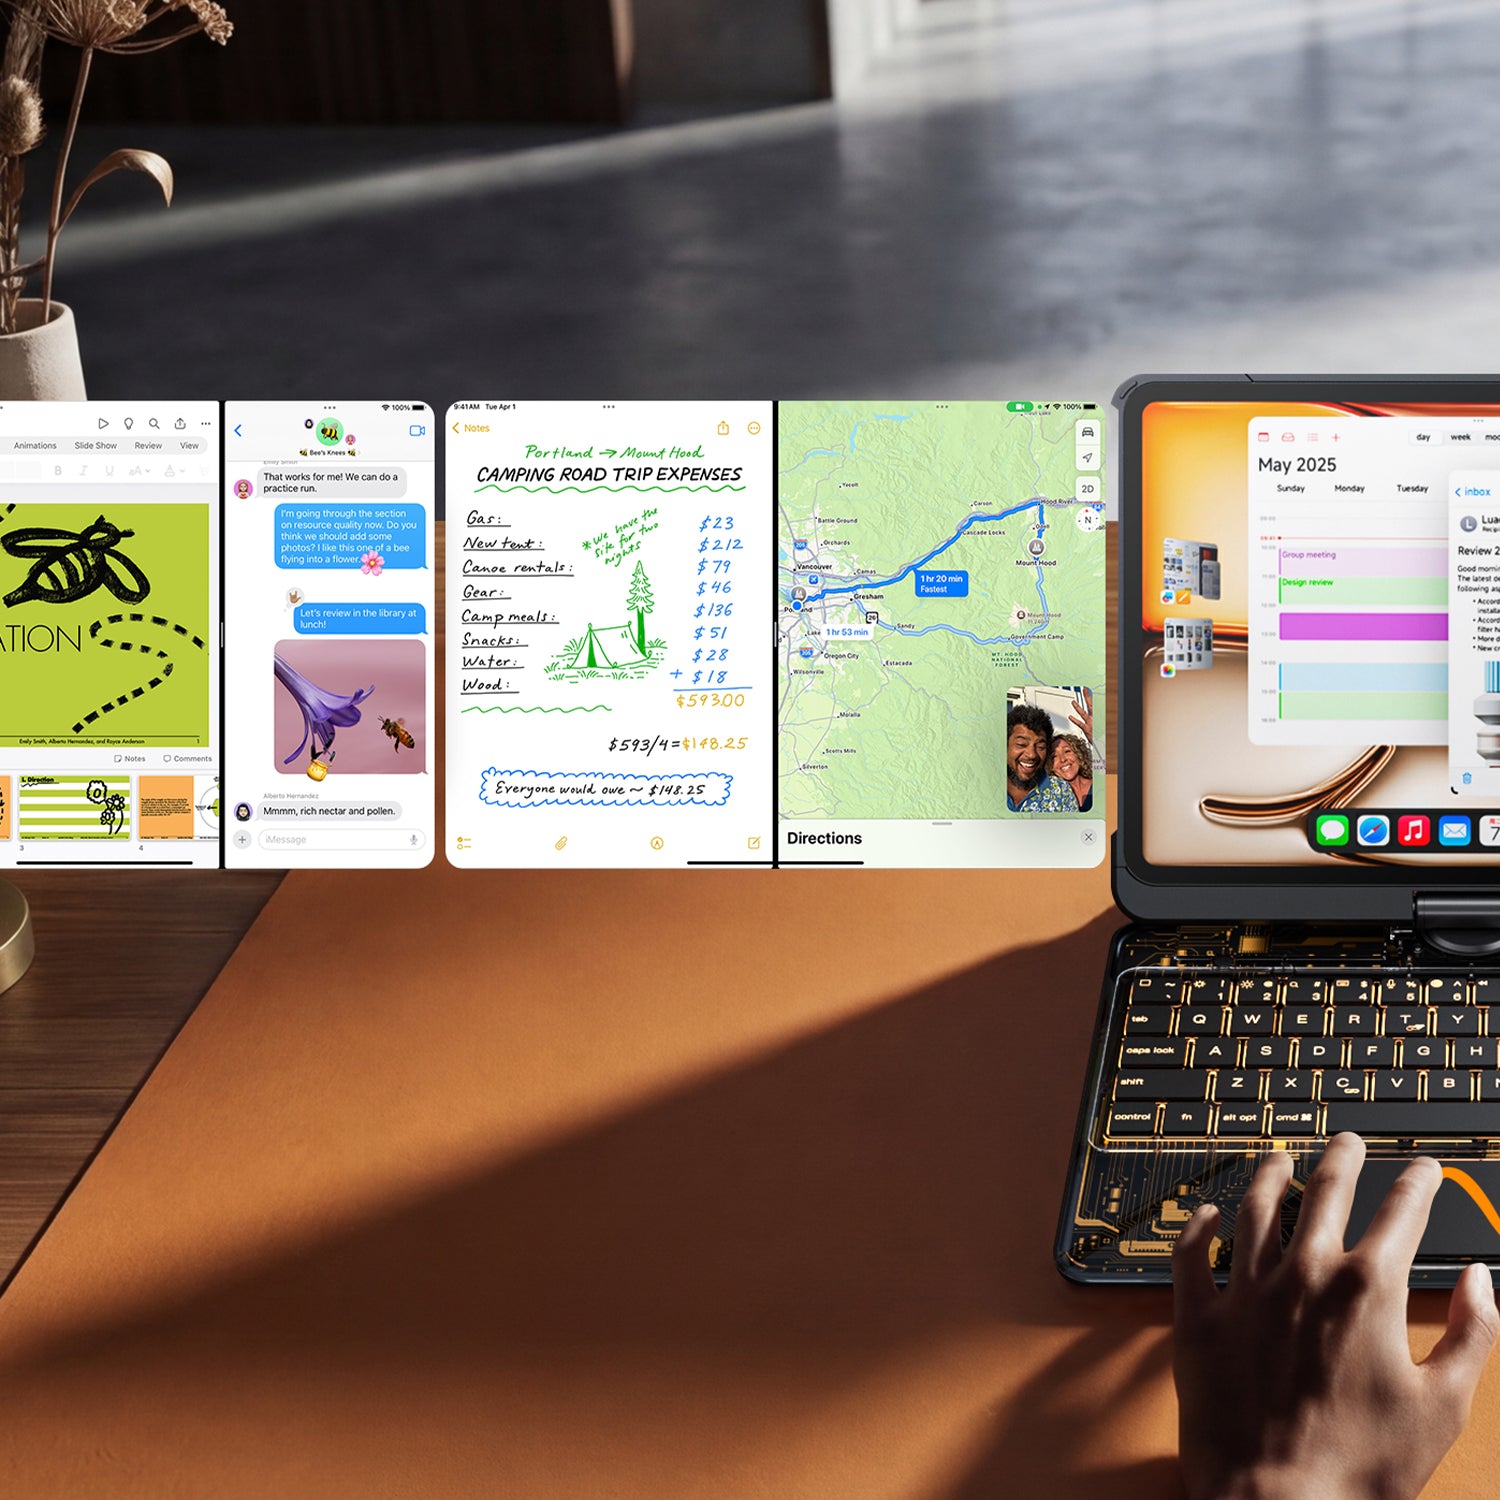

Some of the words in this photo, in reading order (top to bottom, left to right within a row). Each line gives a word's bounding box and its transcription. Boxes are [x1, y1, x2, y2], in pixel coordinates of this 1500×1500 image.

[391, 404, 411, 412] 100%
[485, 403, 498, 411] Tue
[498, 403, 511, 411] Apr
[463, 423, 491, 433] Notes
[1416, 433, 1431, 443] day
[1450, 433, 1471, 441] week
[13, 441, 58, 450] Animations
[74, 441, 94, 450] Slide
[95, 441, 118, 450] Show
[134, 441, 163, 450] Review
[179, 441, 200, 450] View
[309, 449, 326, 457] Bee's
[525, 444, 594, 460] Portland
[619, 446, 666, 460] Mount
[668, 444, 705, 460] Hood
[1259, 458, 1291, 475] May
[1296, 456, 1337, 473] 2025
[477, 466, 556, 483] CAMPING
[559, 467, 608, 482] ROAD
[612, 466, 654, 482] TRIP
[656, 466, 743, 482] EXPENSES
[1081, 484, 1095, 494] 2D
[1276, 483, 1306, 494] Sunday
[1334, 484, 1366, 494] Monday
[1396, 484, 1429, 494] Tuesday
[1464, 487, 1491, 497] inbox
[466, 509, 501, 525] Gas:
[699, 515, 733, 532] $23
[462, 536, 499, 550] New
[501, 536, 545, 550] tent:
[697, 536, 744, 554] $212
[1281, 550, 1305, 560] Group
[1306, 551, 1337, 561] meeting
[1457, 545, 1493, 556] Review
[1494, 545, 1500, 556] 2
[462, 558, 507, 575] Canoe
[513, 560, 573, 573] rentals:
[698, 558, 730, 575] $79
[1015, 558, 1037, 567] Mount
[1039, 558, 1058, 567] Hood
[925, 574, 935, 583] hr
[935, 574, 948, 583] 20
[947, 574, 964, 583] min
[1281, 578, 1307, 588] Design
[1308, 579, 1334, 587] review
[463, 583, 504, 599] Gear:
[695, 580, 732, 597] $46
[920, 584, 948, 593] Fastest
[853, 593, 884, 602] Gresham
[693, 602, 734, 619] $136
[462, 610, 504, 628] Camp
[506, 610, 558, 624] meals:
[461, 631, 520, 646] Snacks:
[693, 625, 728, 641] $51
[691, 647, 729, 664] $28
[462, 655, 517, 668] Water:
[691, 669, 728, 685] $18
[462, 677, 510, 692] Wood:
[124, 755, 146, 763] Notes
[173, 754, 213, 763] Comments
[495, 780, 555, 798] Everyone
[559, 783, 598, 796] would
[601, 785, 627, 796] owe
[648, 783, 707, 798] $148.25
[263, 806, 299, 817] Mmmm,
[300, 806, 318, 816] rich
[318, 807, 347, 816] nectar
[348, 806, 365, 816] and
[367, 806, 397, 819] pollen.
[1491, 823, 1500, 840] 7
[265, 833, 307, 846] iMessage
[787, 831, 863, 845] Directions
[1131, 1015, 1149, 1023] tab
[1192, 1013, 1207, 1025] Q
[1244, 1014, 1261, 1024] W
[1296, 1014, 1308, 1024] E
[1348, 1014, 1361, 1025] R
[1399, 1014, 1412, 1025] T
[1451, 1014, 1464, 1025] Y
[1152, 1046, 1175, 1054] lock
[1120, 1078, 1145, 1086] shift
[1114, 1113, 1152, 1121] control
[1181, 1113, 1193, 1121] fn
[1222, 1113, 1237, 1122] alt
[1238, 1114, 1258, 1123] opt
[1275, 1113, 1300, 1122] cmd
